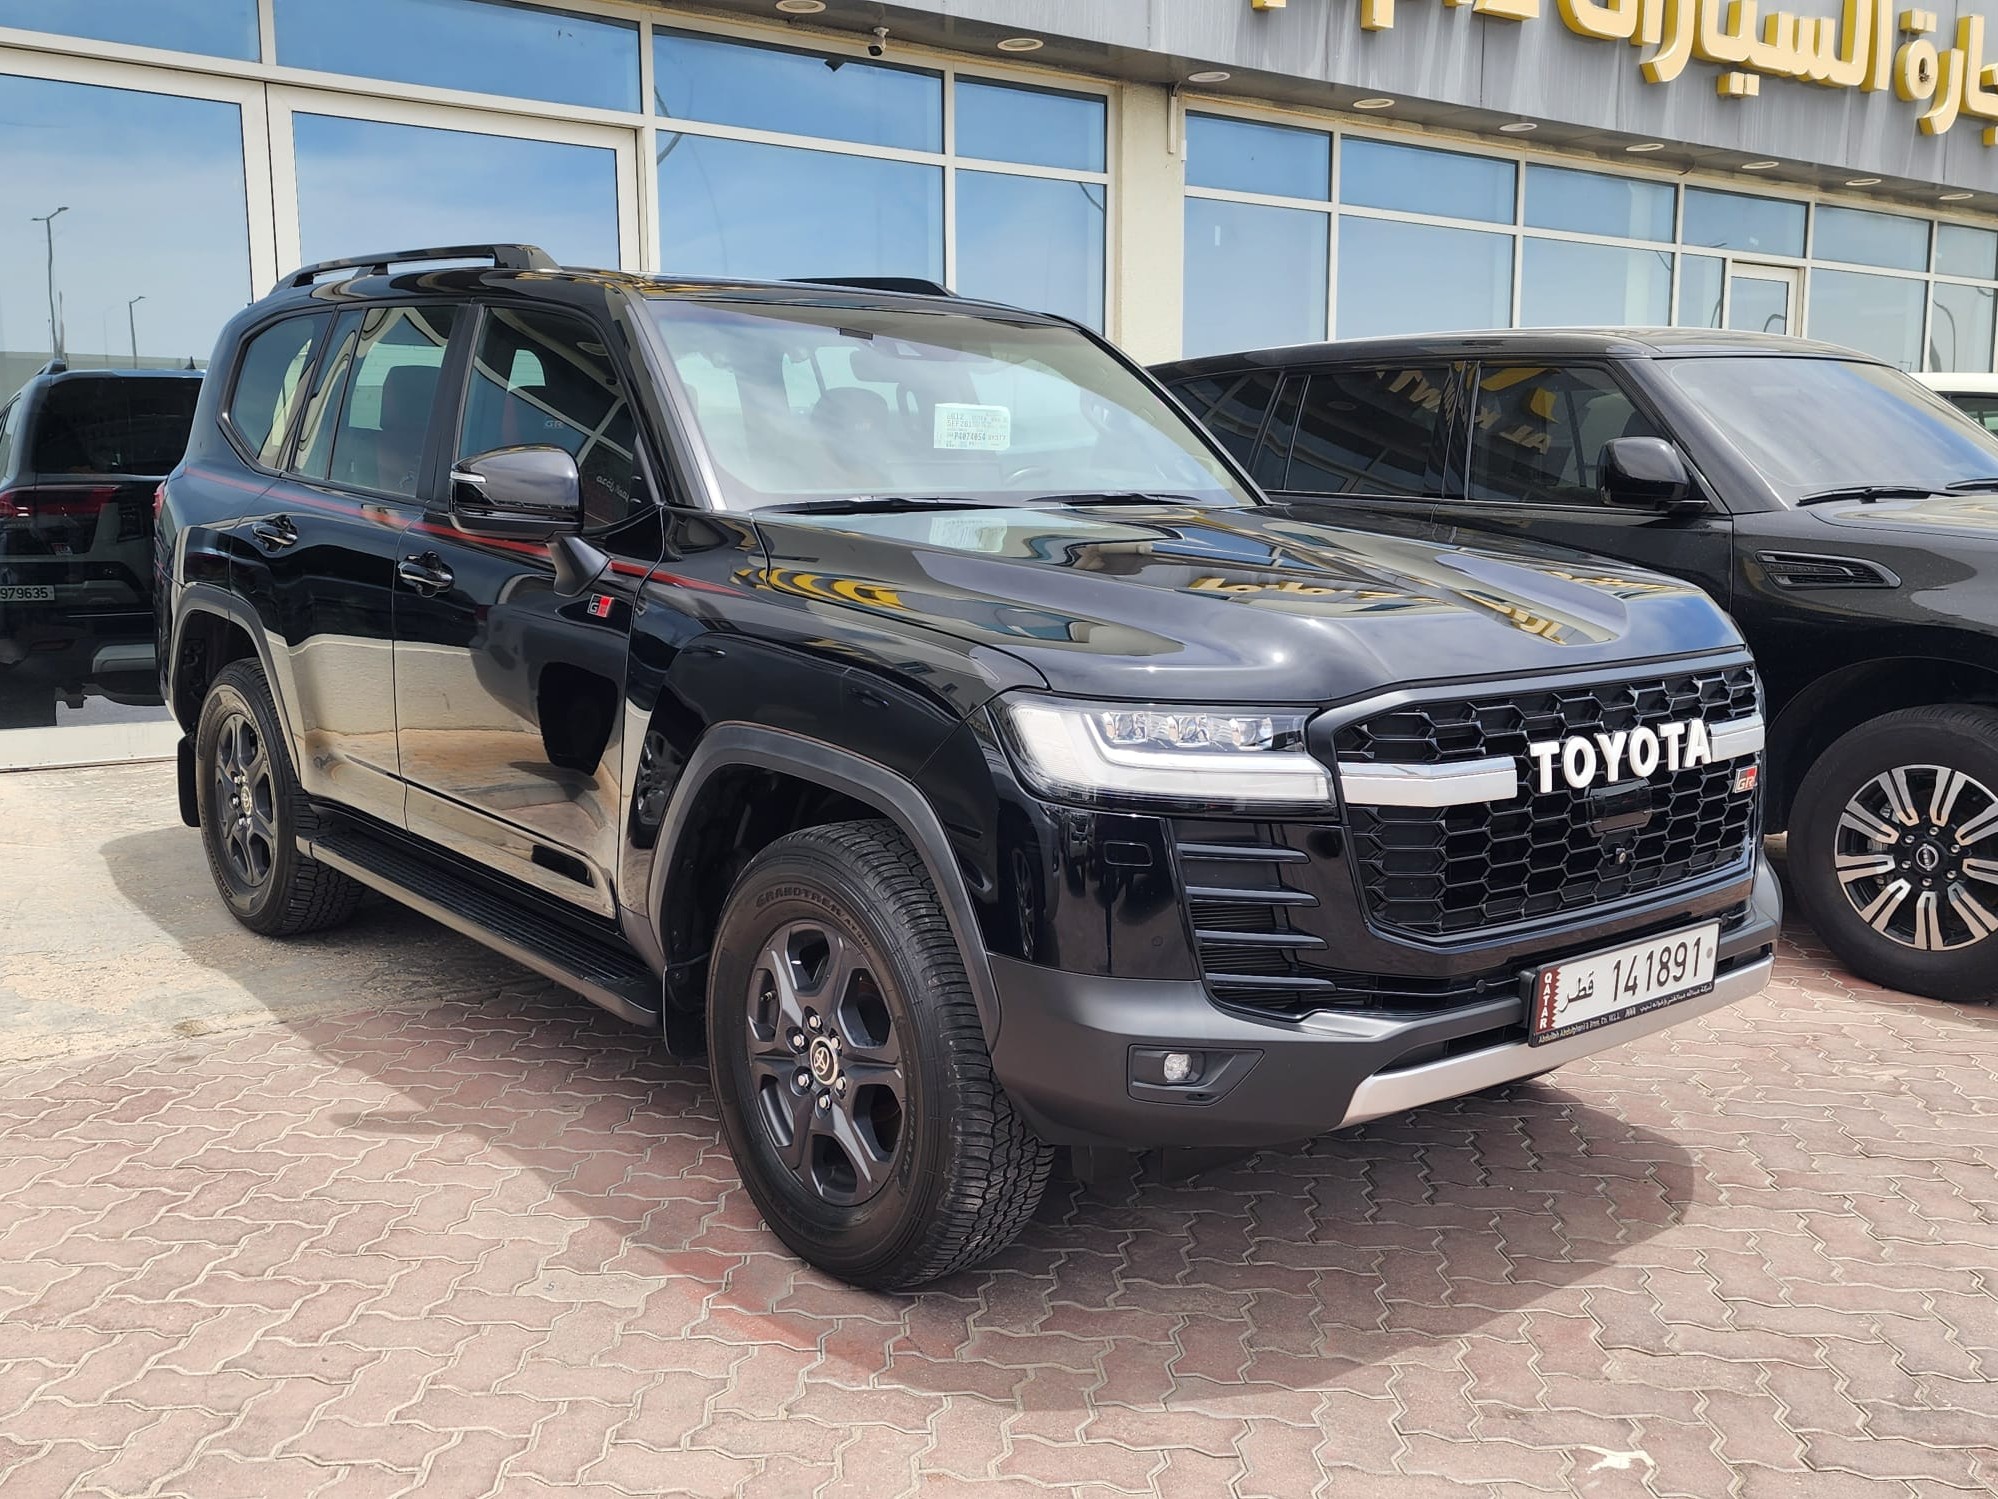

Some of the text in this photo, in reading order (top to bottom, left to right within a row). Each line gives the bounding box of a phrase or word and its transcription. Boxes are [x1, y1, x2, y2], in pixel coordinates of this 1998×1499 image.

[0, 587, 49, 600] 979635
[1530, 717, 1712, 794] TOYOTA
[1735, 775, 1756, 791] GR
[1558, 969, 1595, 1013] قطر
[1612, 936, 1702, 1002] 141891
[1539, 972, 1553, 1030] QATAR
